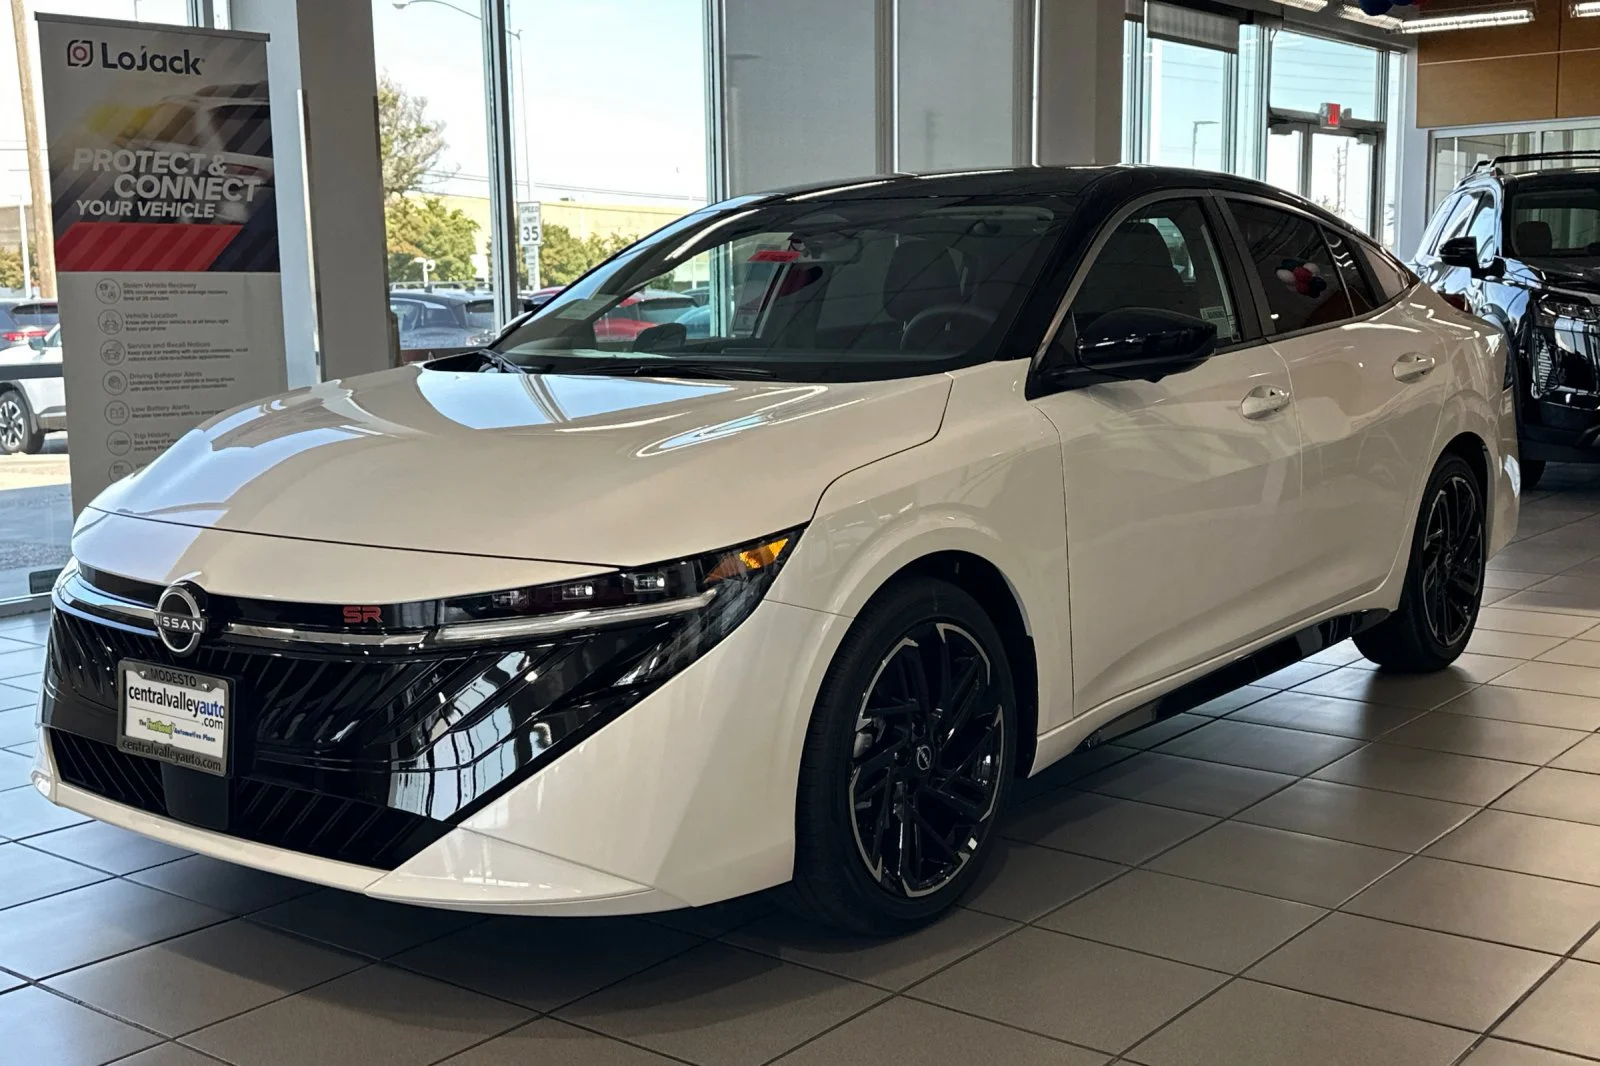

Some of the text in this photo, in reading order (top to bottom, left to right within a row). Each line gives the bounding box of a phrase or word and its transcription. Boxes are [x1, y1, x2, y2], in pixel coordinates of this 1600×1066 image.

[72, 148, 207, 175] PROTECT
[114, 174, 262, 202] CONNECT
[76, 200, 215, 219] YOUR VEHICLE
[523, 226, 539, 241] 35
[154, 614, 203, 631] NISSAN
[343, 606, 383, 623] SR
[150, 668, 197, 687] MODESTO
[128, 686, 225, 718] centralvalleyauto
[201, 718, 224, 730] .com
[122, 740, 221, 771] centralvalleyauto.com
